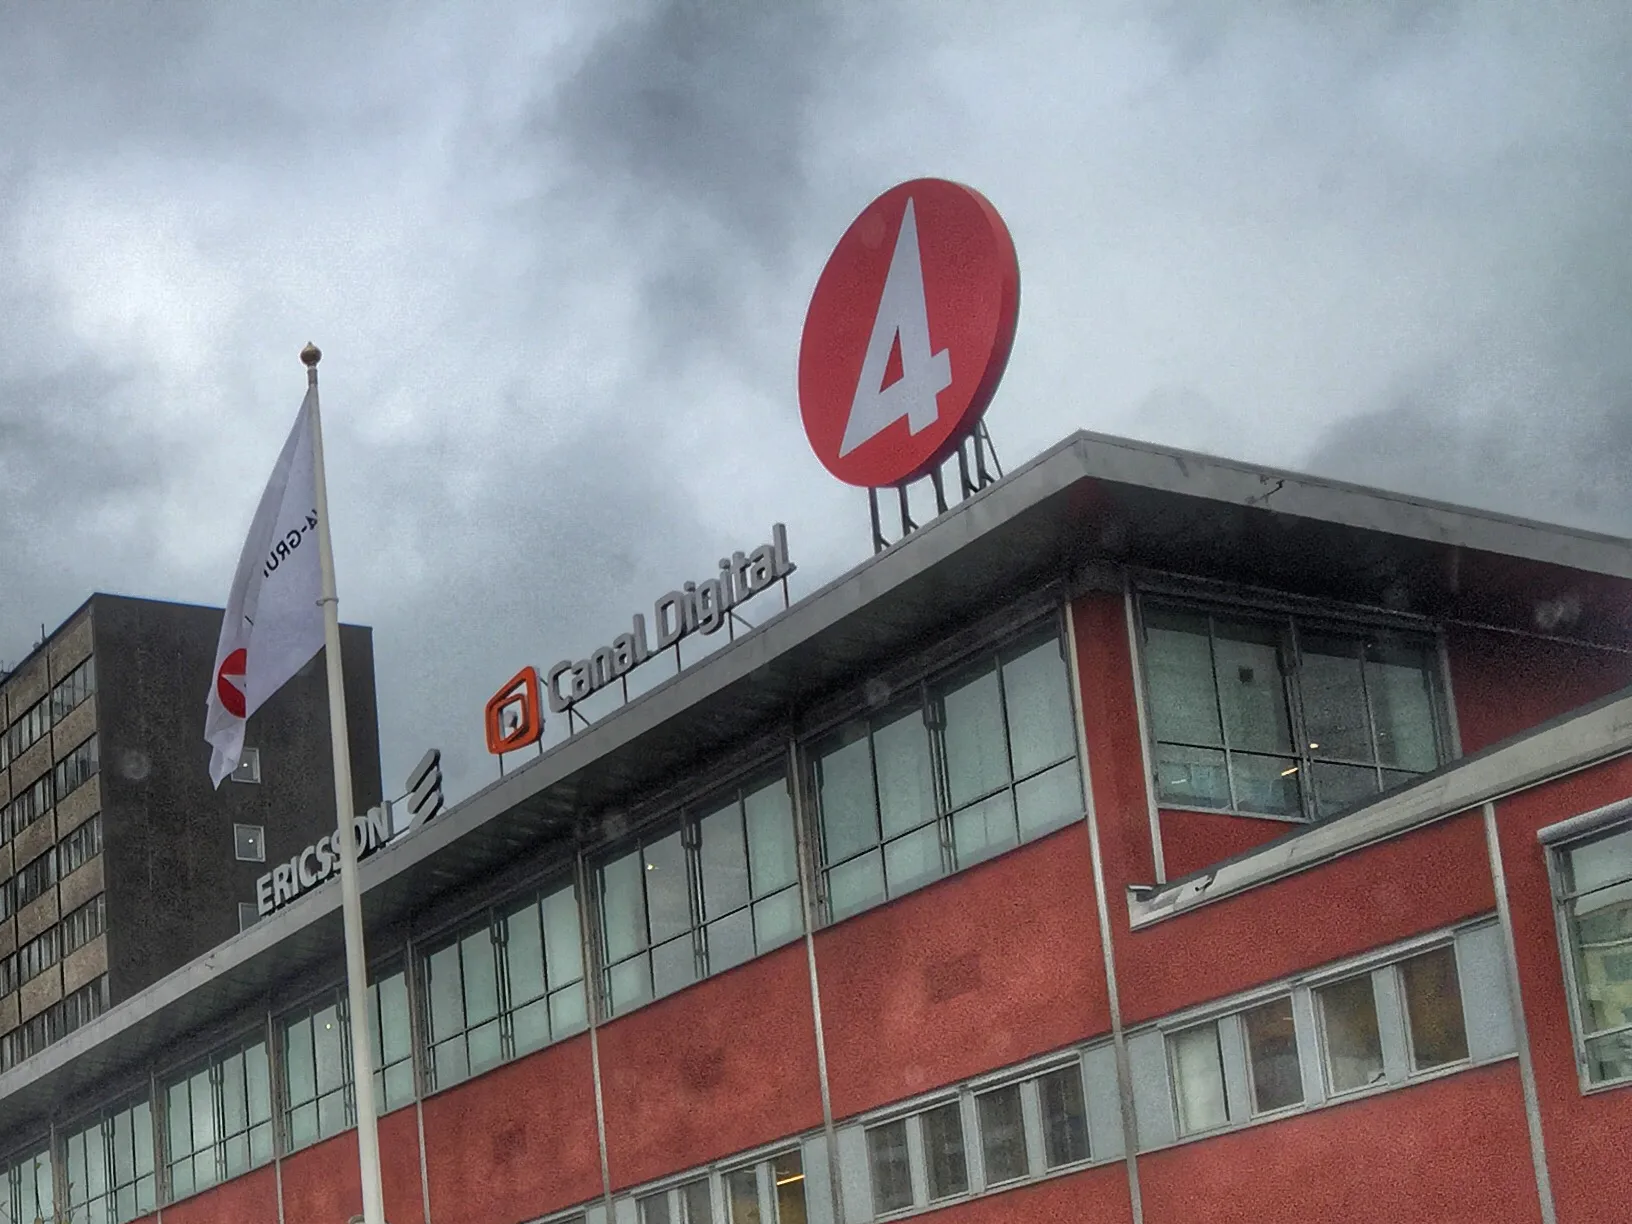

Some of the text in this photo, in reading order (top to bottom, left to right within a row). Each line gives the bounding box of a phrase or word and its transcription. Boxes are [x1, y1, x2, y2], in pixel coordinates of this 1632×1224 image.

[837, 196, 953, 459] 4
[547, 522, 798, 714] Canal Digital
[256, 799, 394, 917] ERICSSON
